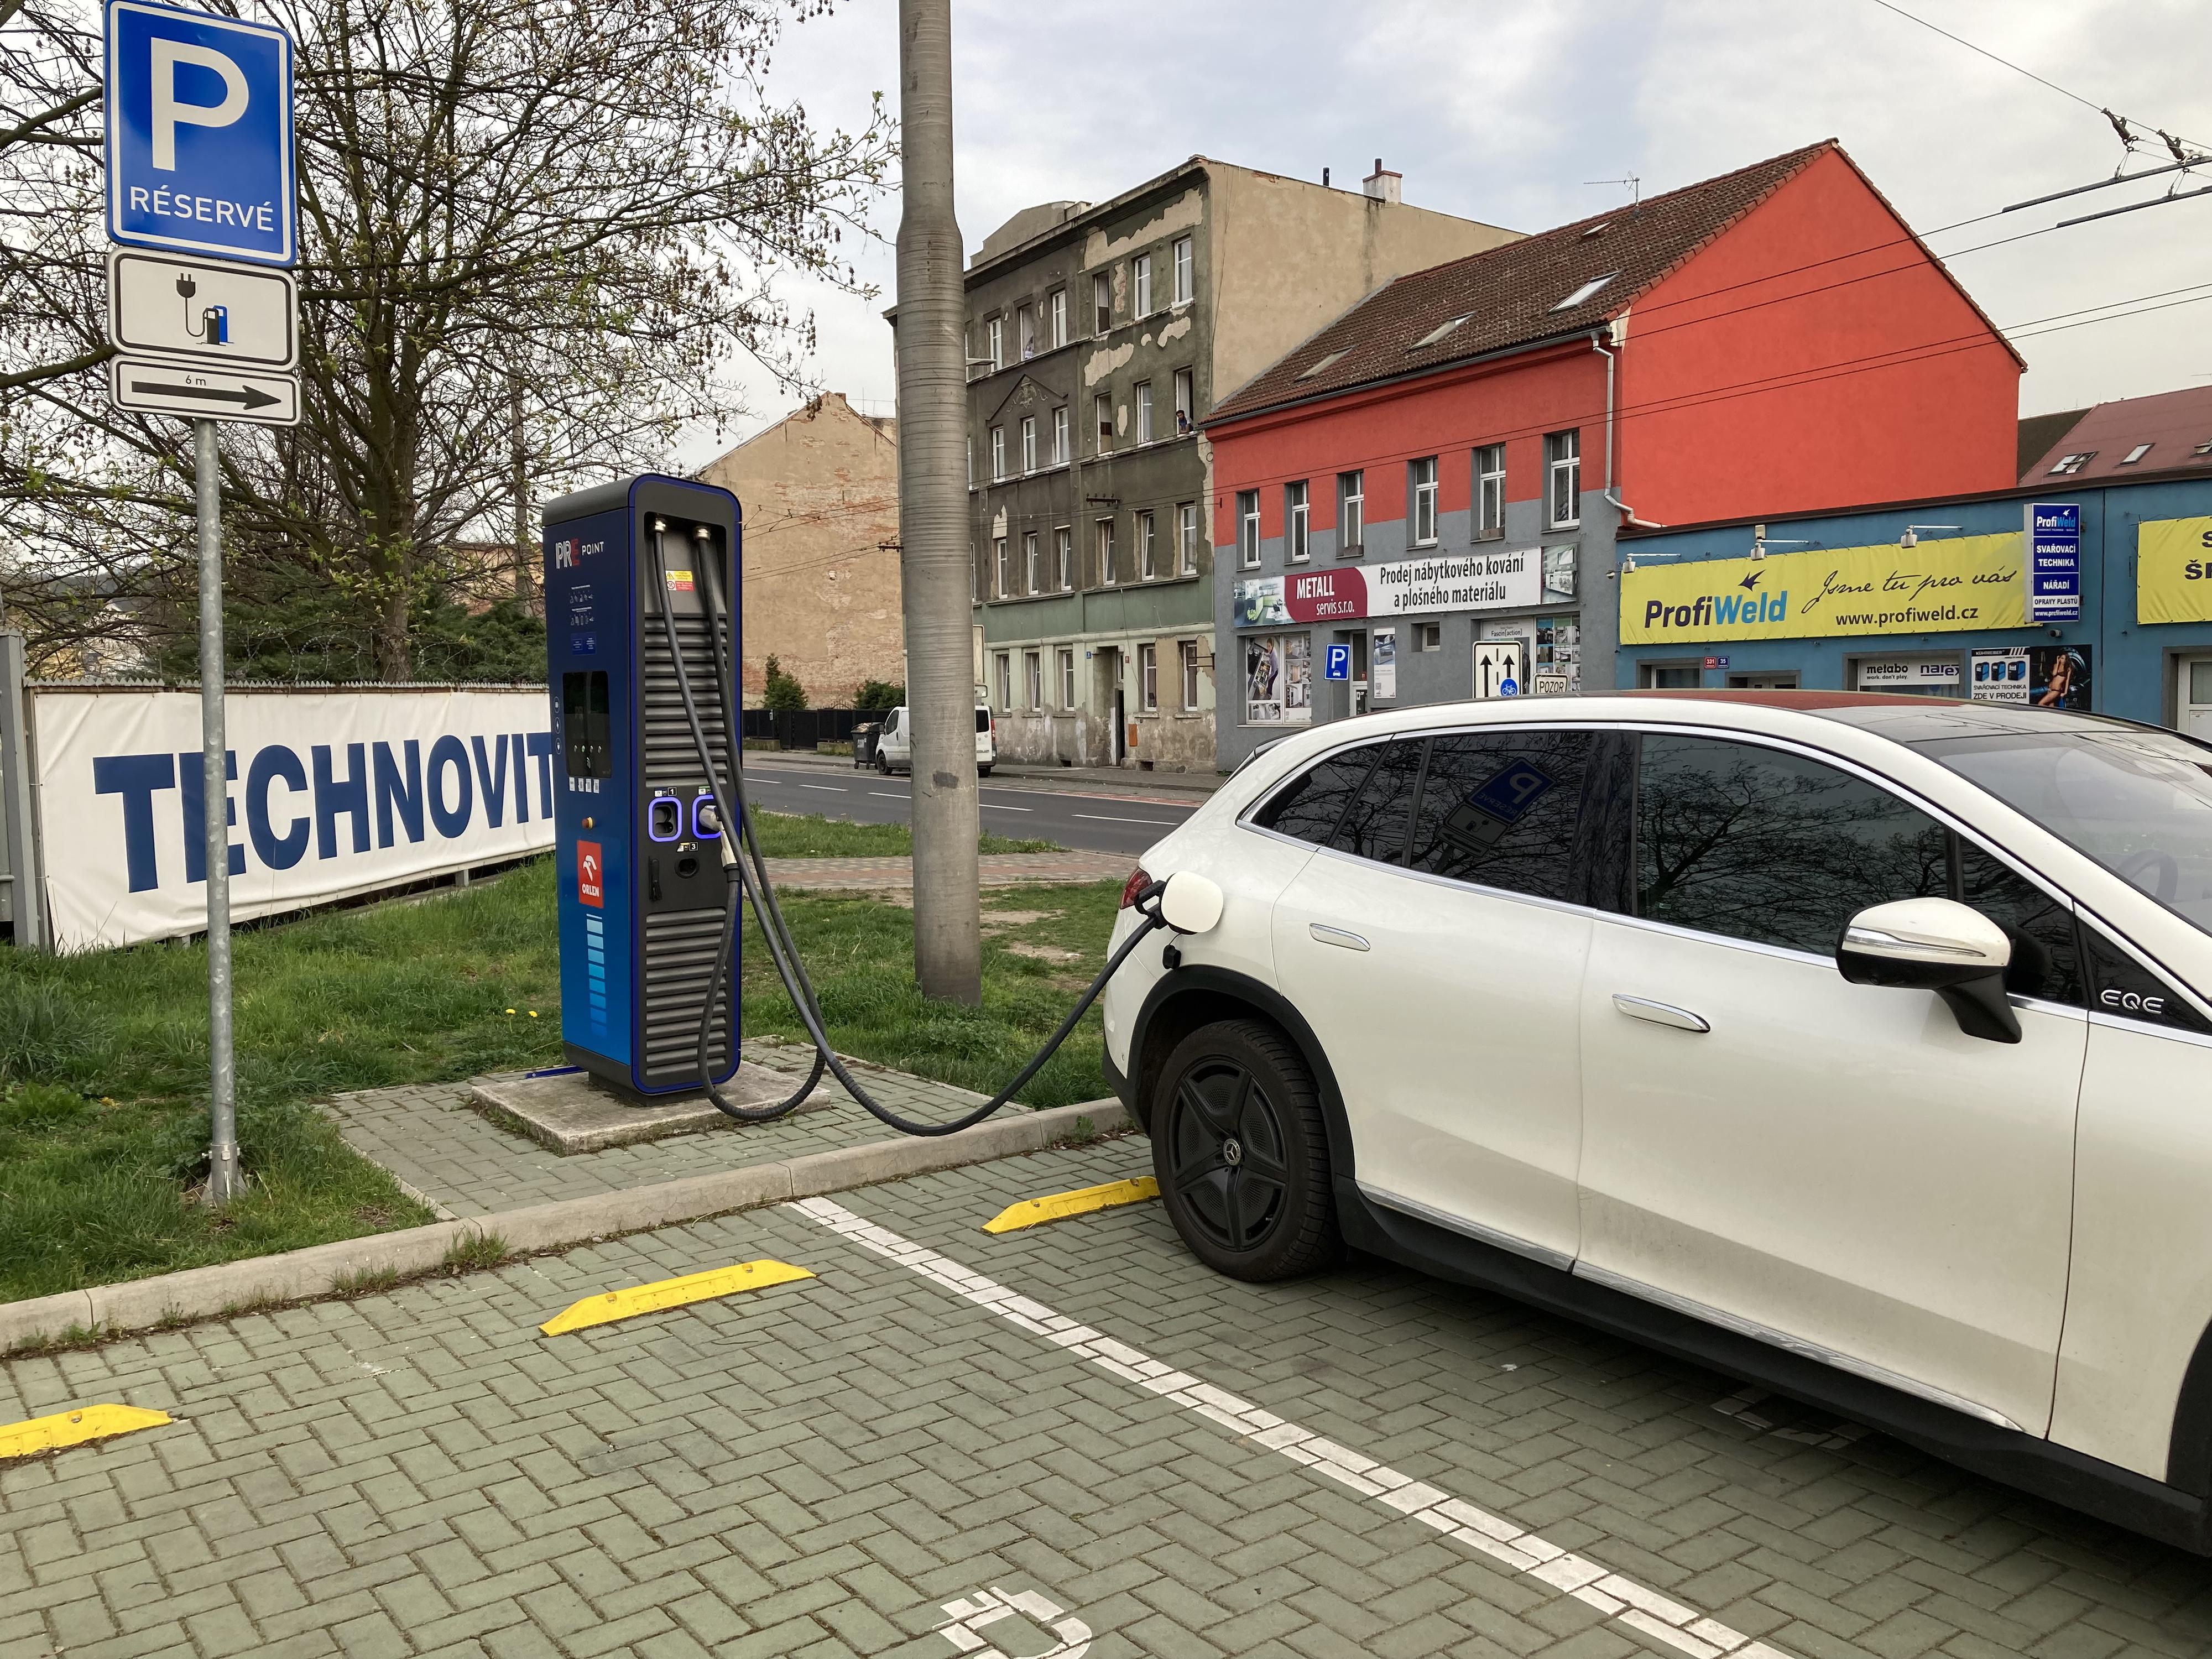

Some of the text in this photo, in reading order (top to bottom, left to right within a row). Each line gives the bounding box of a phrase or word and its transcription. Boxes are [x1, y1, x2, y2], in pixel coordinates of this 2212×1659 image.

[151, 37, 249, 171] P
[129, 185, 274, 232] RÉSERVÉ
[186, 375, 206, 387] 6 m
[2037, 516, 2076, 527] ProfiWeld
[555, 538, 604, 569] PRE POINT
[2037, 543, 2076, 553] SVAŘOVACÍ
[1380, 552, 1525, 587] Prodej nábytkového kování
[1296, 575, 1334, 599] METALL
[1882, 570, 1922, 591] tu
[1908, 574, 1963, 601] pro
[1971, 566, 2017, 585] vás
[2043, 580, 2070, 589] NÁŘADÍ
[1316, 598, 1354, 615] servis s.r.o.
[1394, 581, 1506, 611] a plošného materiálu
[1645, 590, 1788, 629] ProfiWeld
[1836, 605, 1978, 627] www.profiweld.cz
[1331, 649, 1346, 669] P
[1866, 664, 1908, 674] metabo
[1540, 681, 1564, 693] POZOR
[582, 883, 599, 897] ORLEN
[2101, 989, 2164, 1015] EQE
